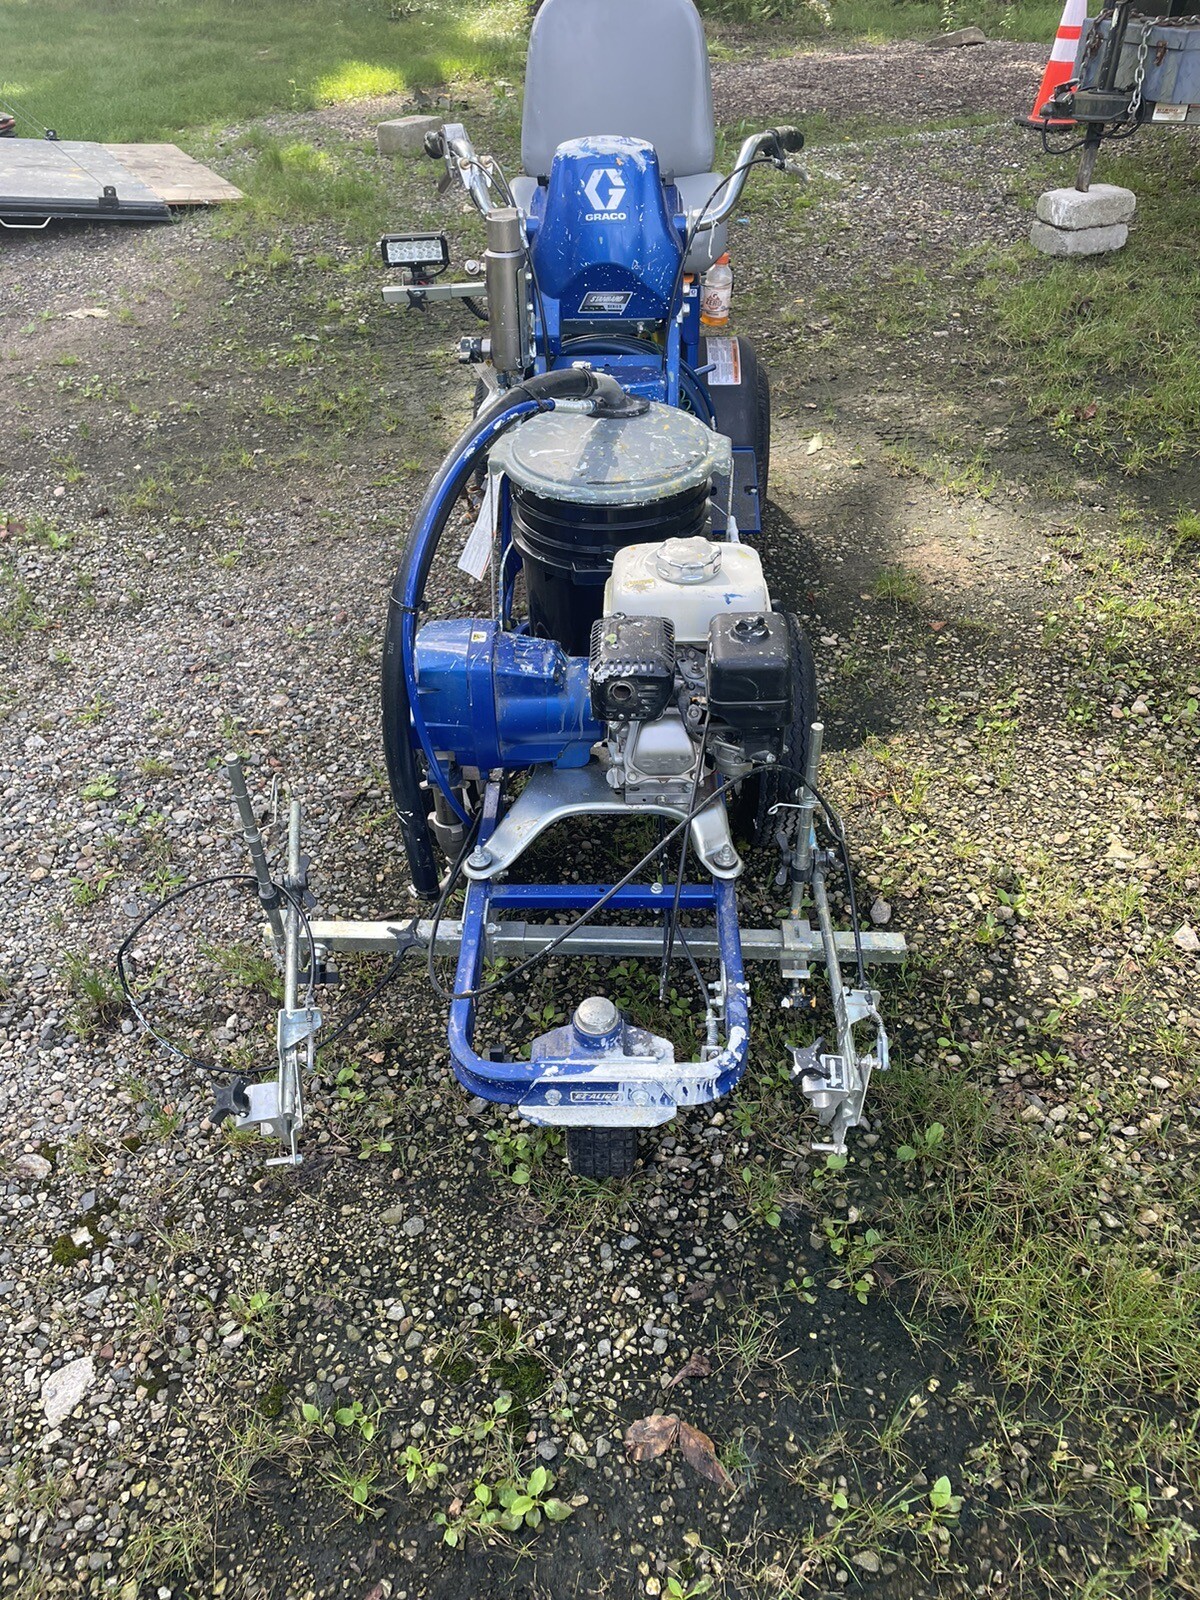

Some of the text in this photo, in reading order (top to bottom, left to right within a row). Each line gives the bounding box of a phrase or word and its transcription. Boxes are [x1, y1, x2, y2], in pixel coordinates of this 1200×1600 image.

[585, 212, 627, 221] GRACO
[590, 295, 624, 303] STANDARD
[705, 297, 723, 306] ZERO
